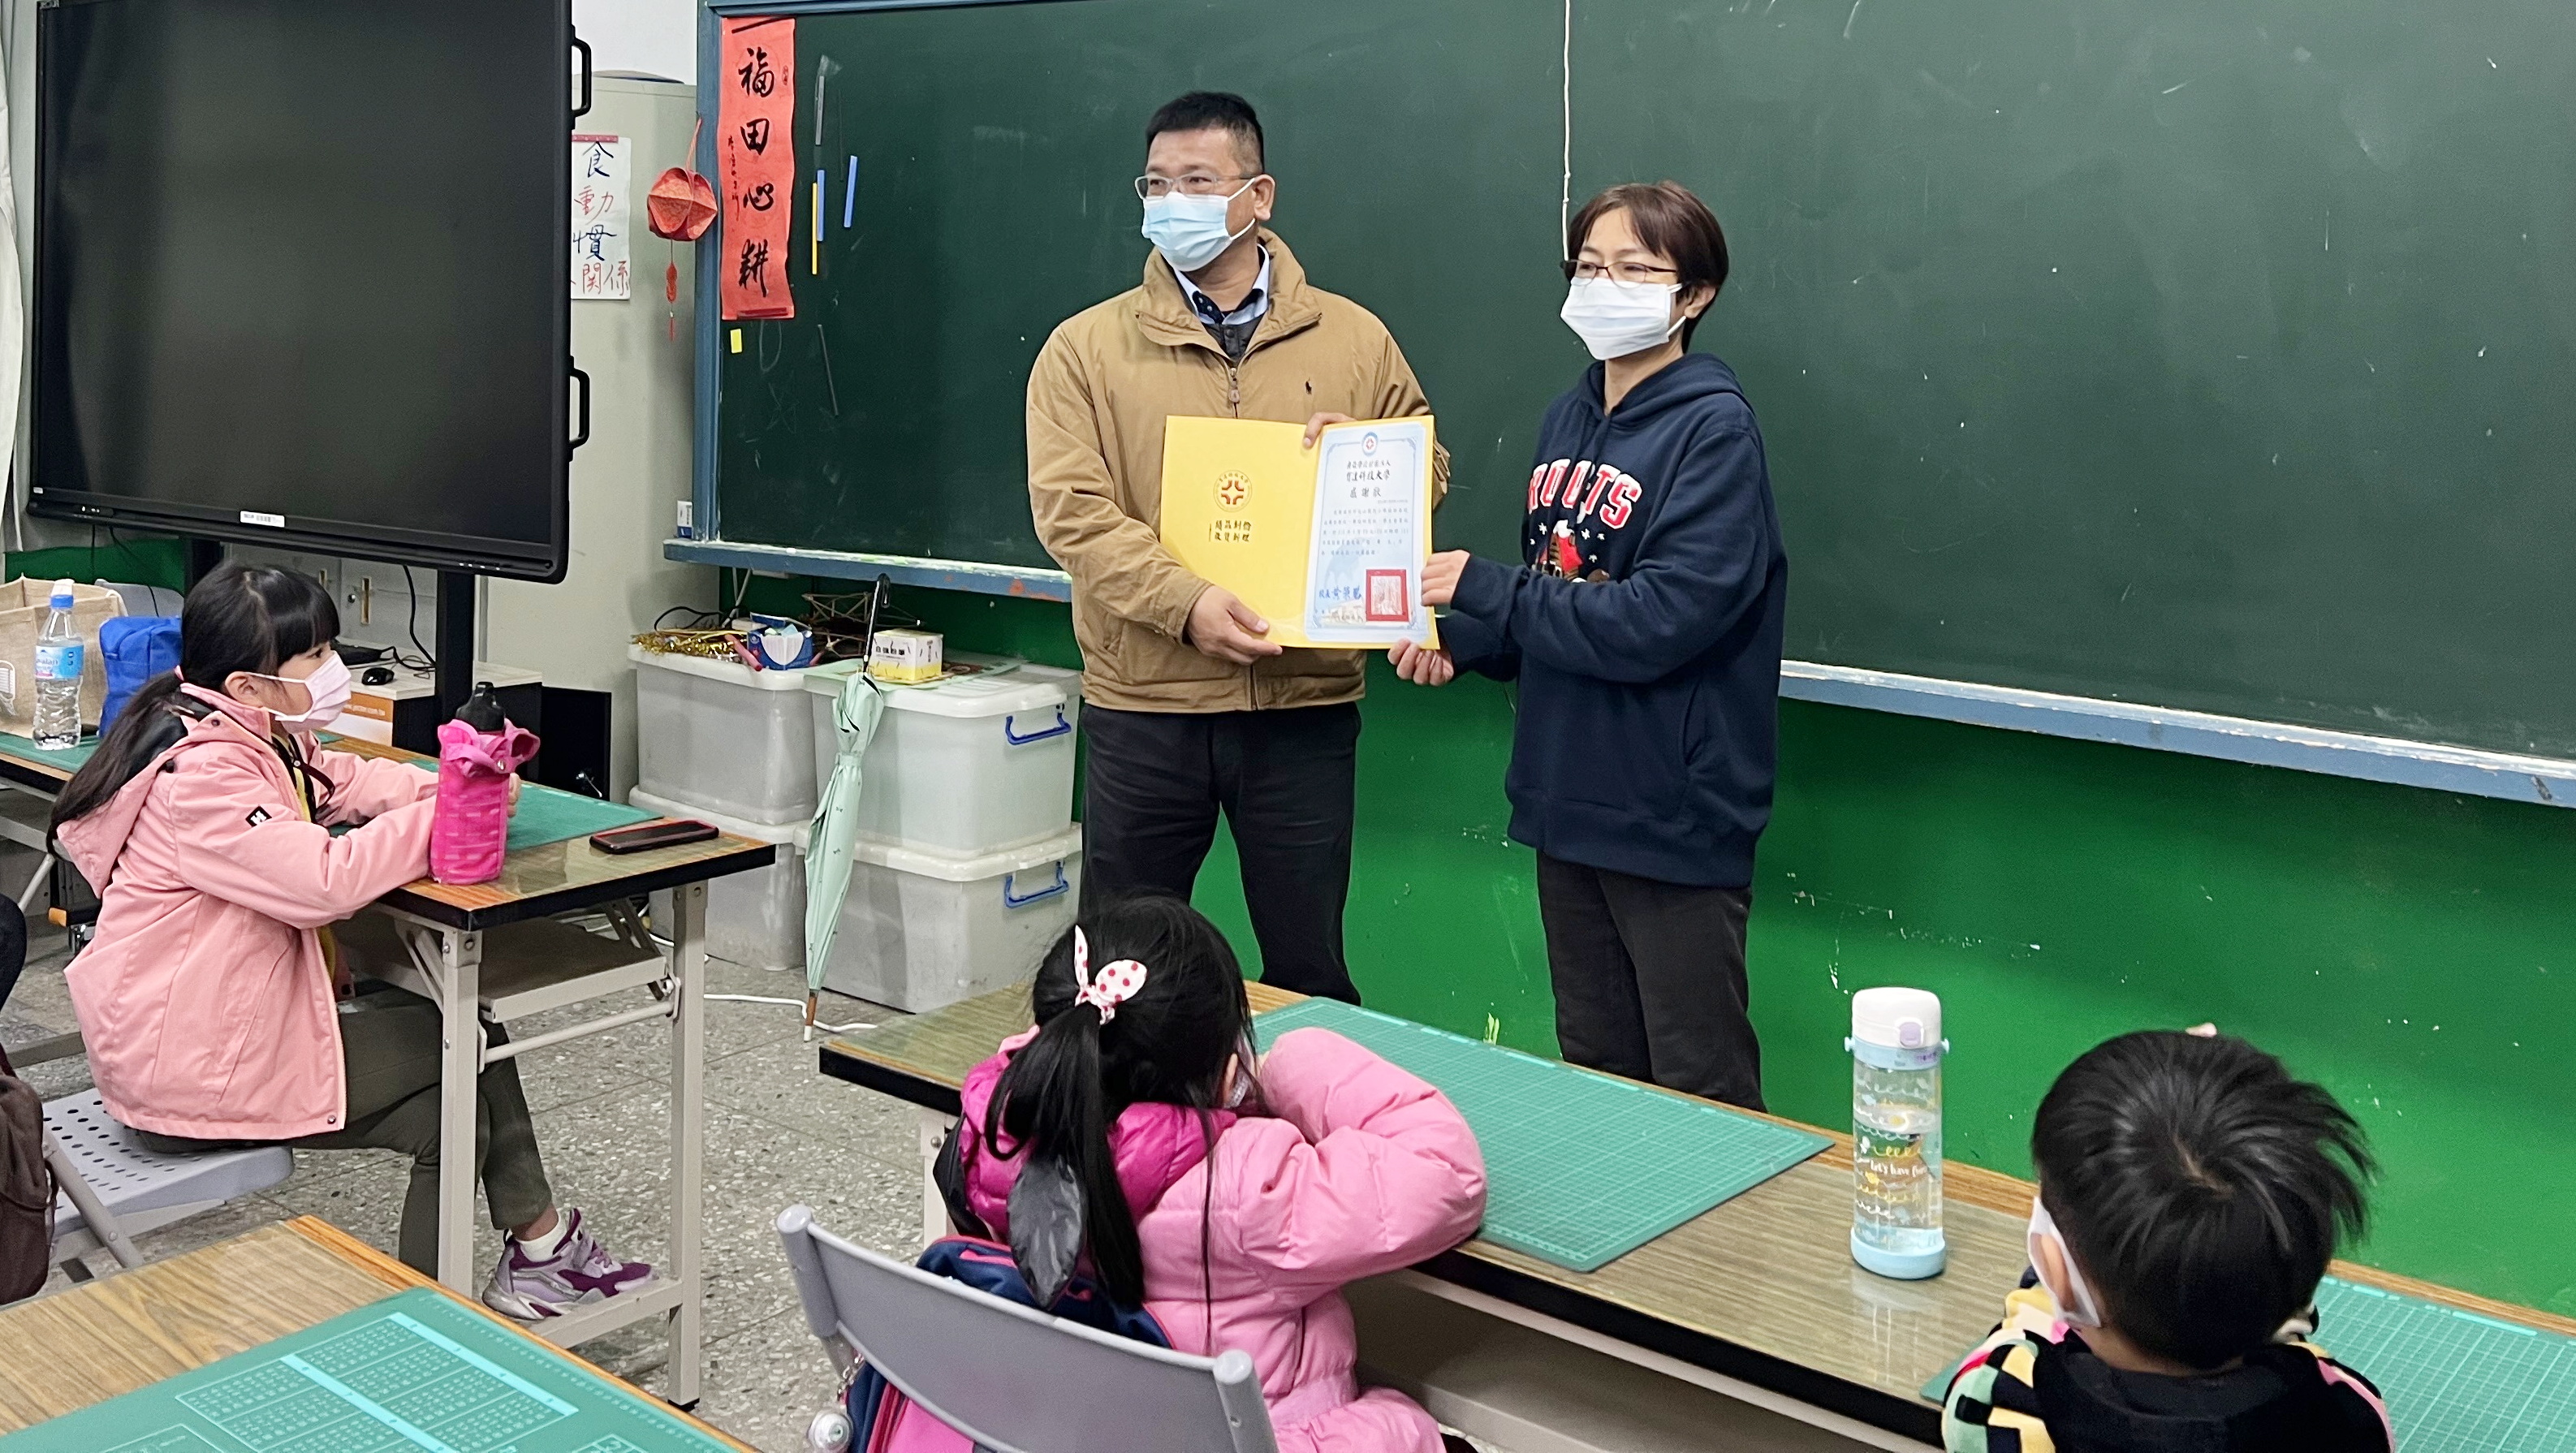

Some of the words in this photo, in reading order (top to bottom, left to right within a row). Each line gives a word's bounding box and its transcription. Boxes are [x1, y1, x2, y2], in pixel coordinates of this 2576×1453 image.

[582, 141, 614, 178] 食
[738, 46, 775, 298] 福田心耕
[574, 184, 614, 226] 動
[572, 224, 617, 261] 慣
